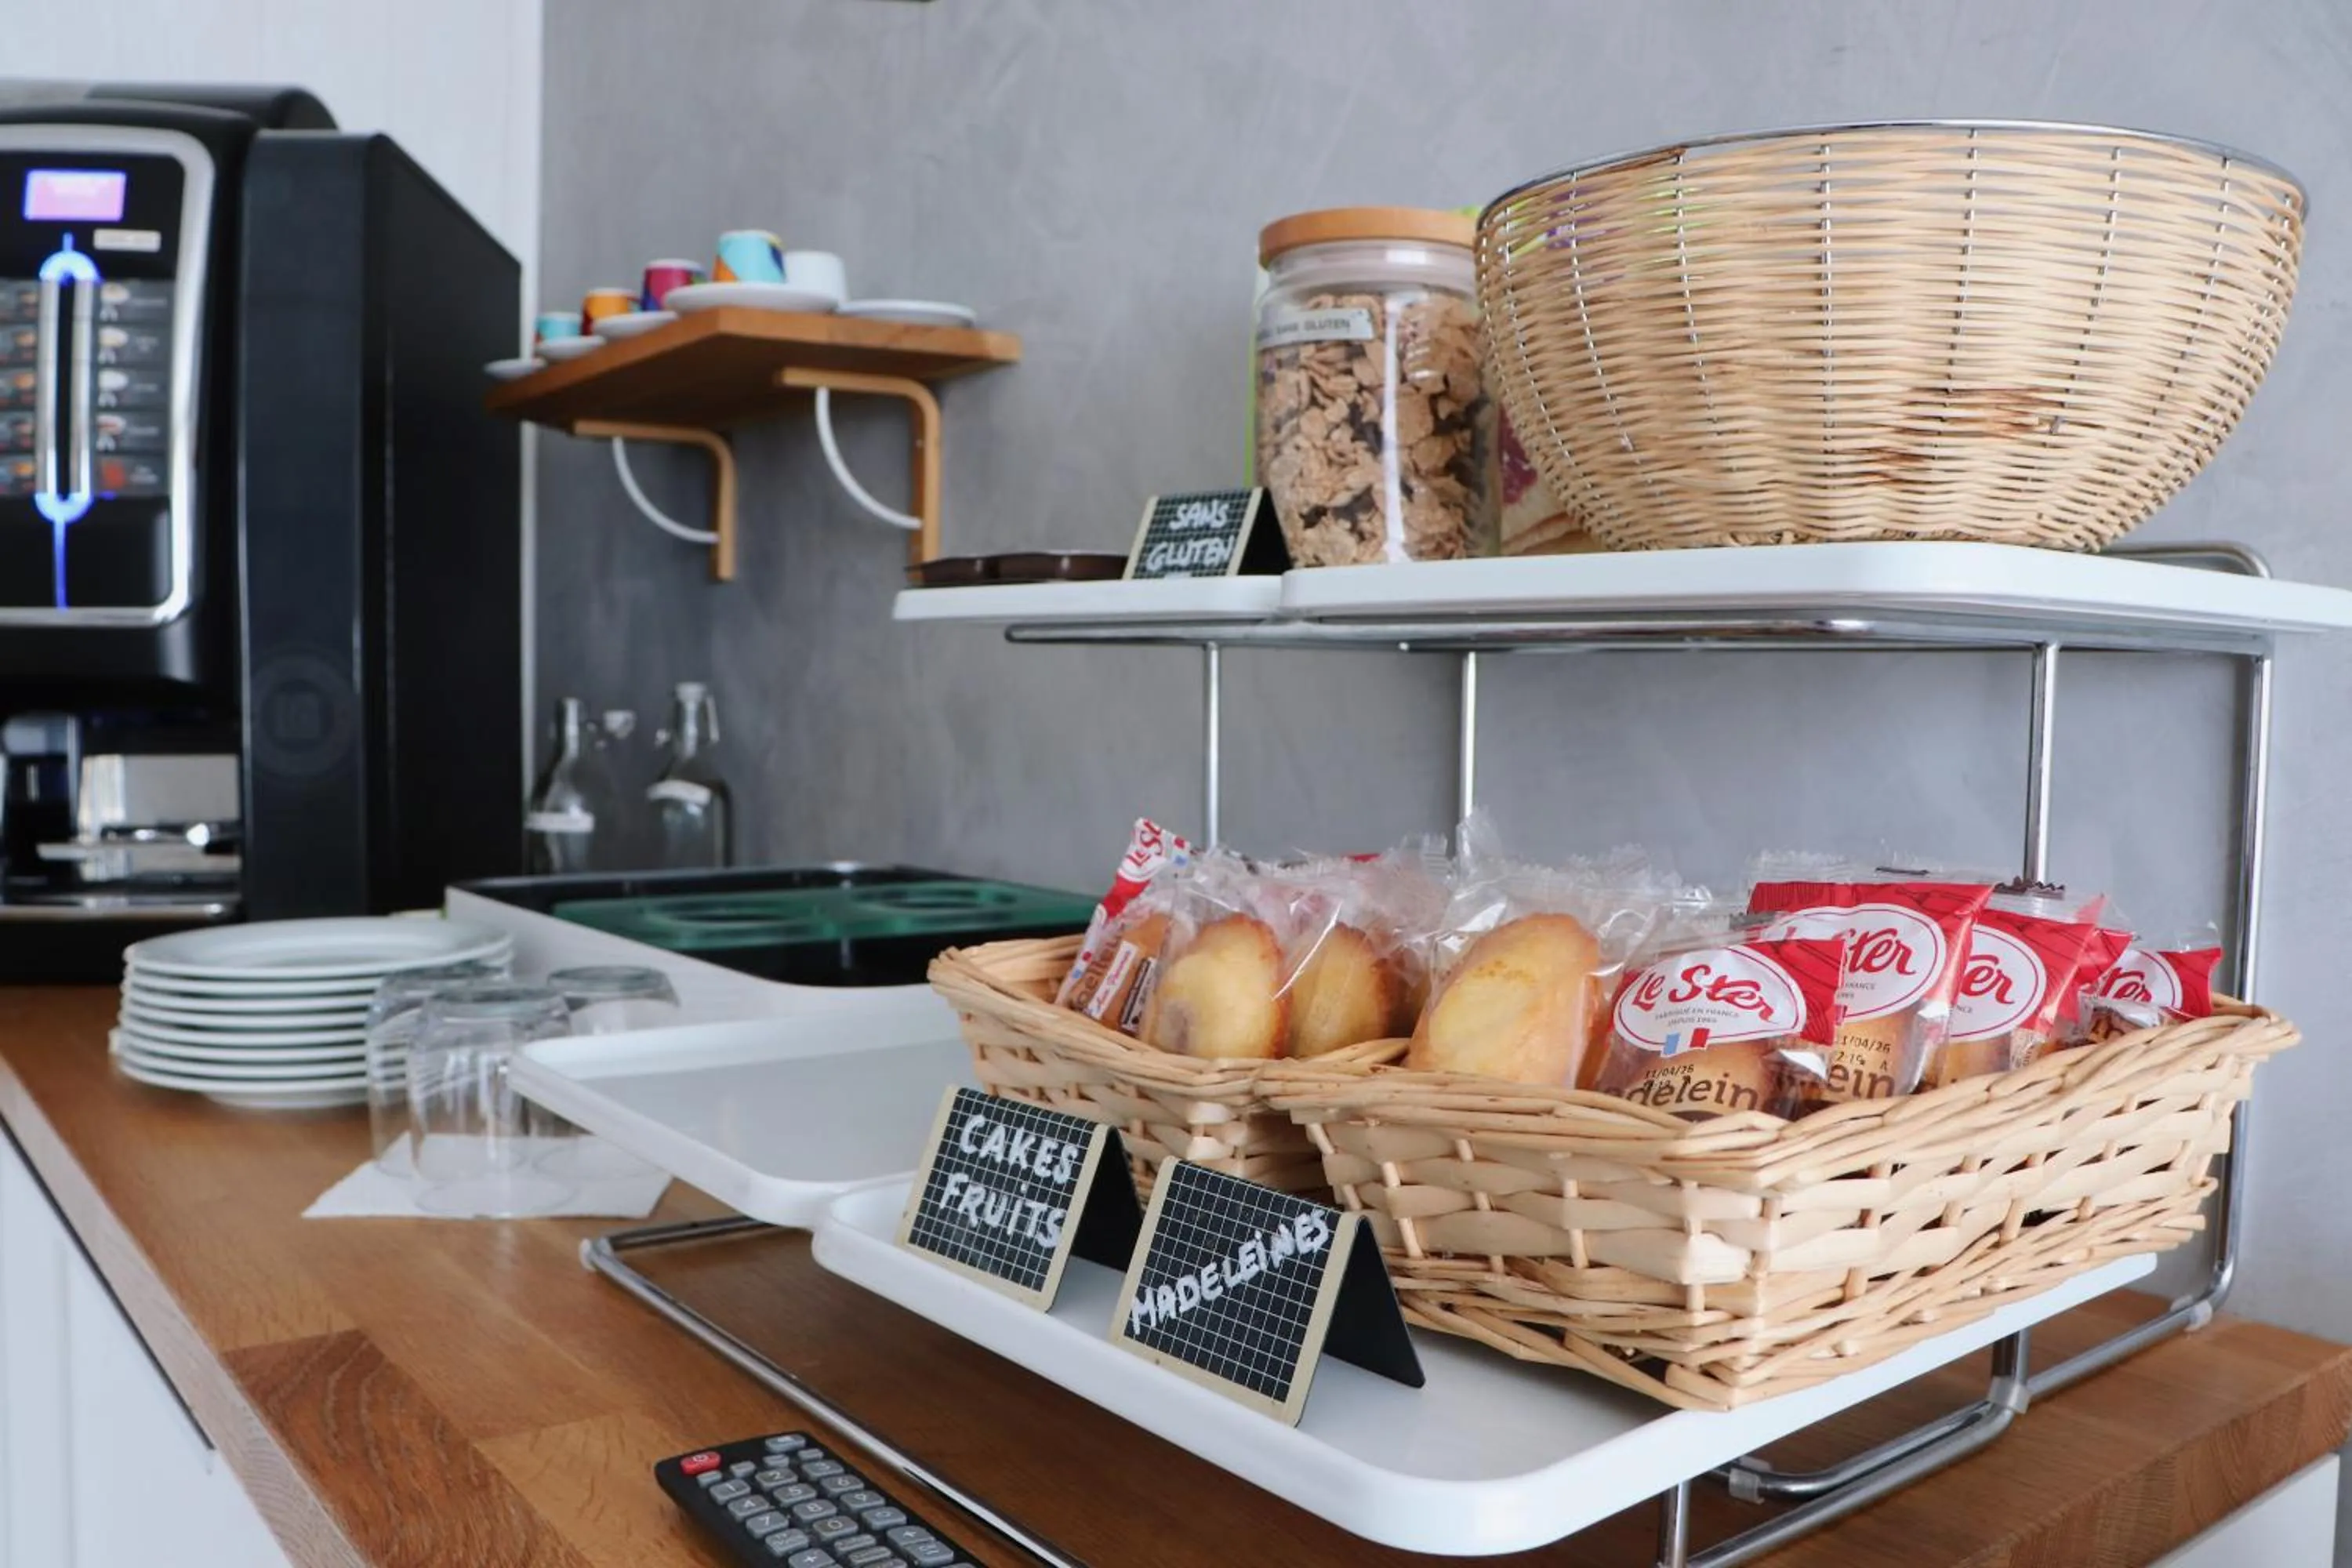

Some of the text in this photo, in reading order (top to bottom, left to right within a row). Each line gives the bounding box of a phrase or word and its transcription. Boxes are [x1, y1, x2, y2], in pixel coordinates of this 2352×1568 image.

[1169, 499, 1230, 530] SANS
[1145, 535, 1235, 572] GLUTEN
[1632, 964, 1776, 1023] Le Ster
[1960, 953, 2015, 1005] er
[2082, 967, 2152, 1003] ter
[1842, 1035, 1891, 1054] 1/04/26
[960, 1114, 1079, 1185] CAKES
